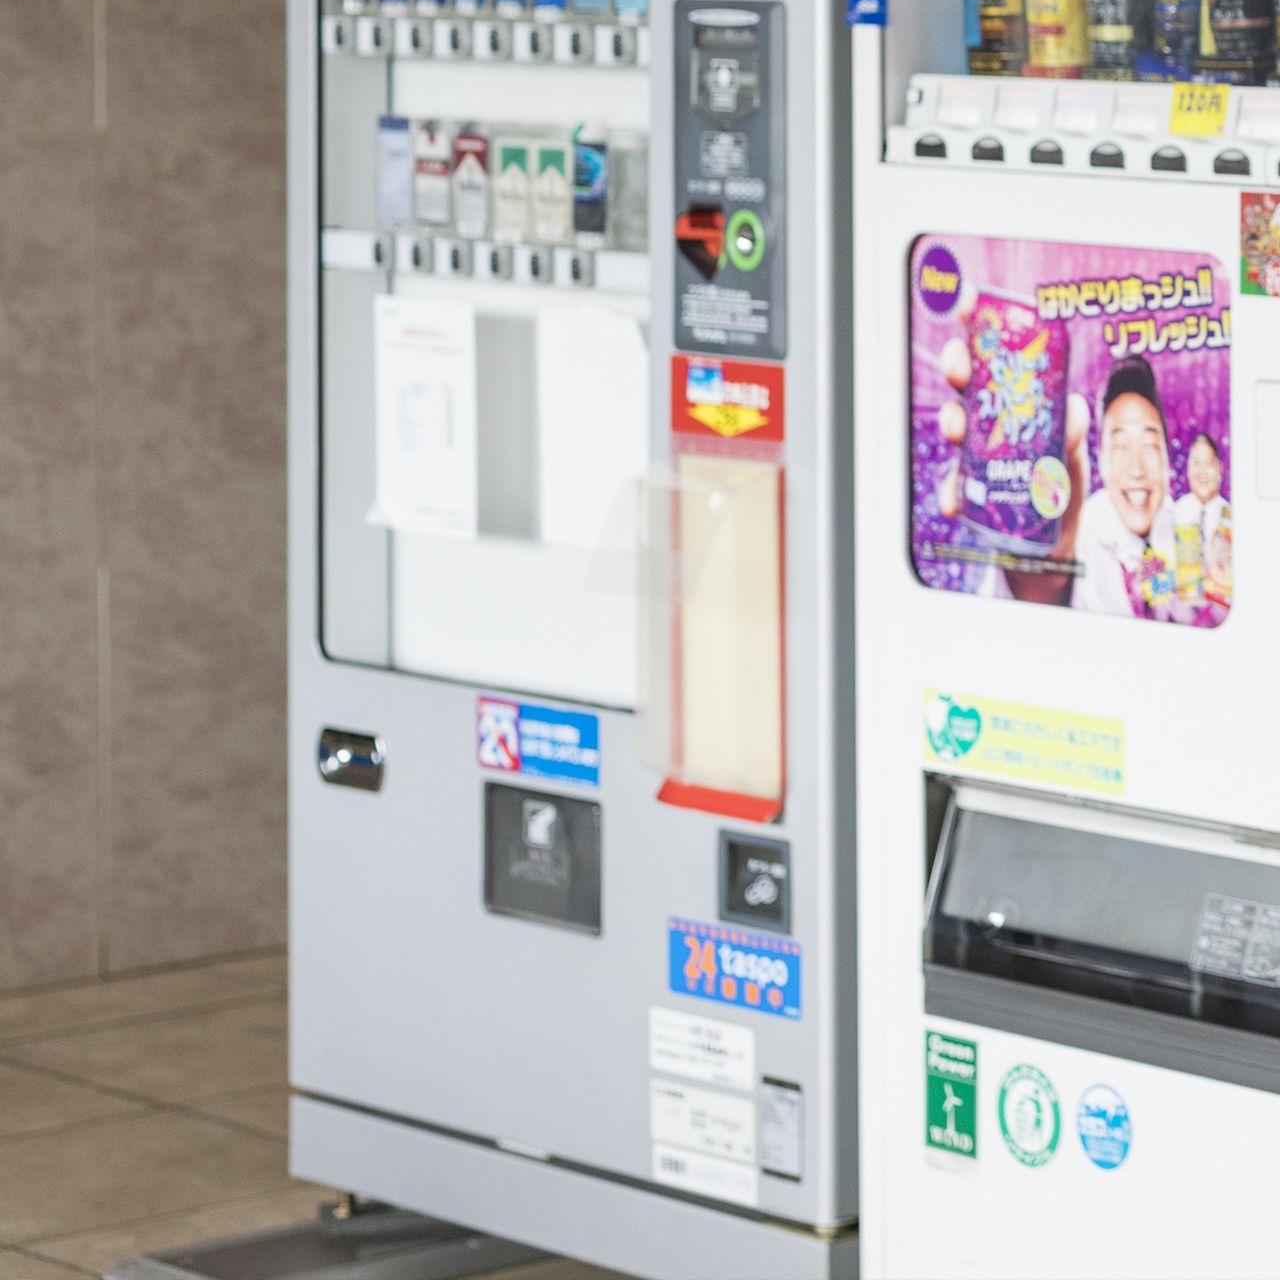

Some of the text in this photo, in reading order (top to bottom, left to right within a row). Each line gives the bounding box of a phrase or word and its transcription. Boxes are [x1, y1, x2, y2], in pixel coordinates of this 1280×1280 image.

[1177, 93, 1221, 115] 120円
[920, 266, 960, 293] New
[717, 942, 789, 990] taspo
[928, 1034, 975, 1062] Green
